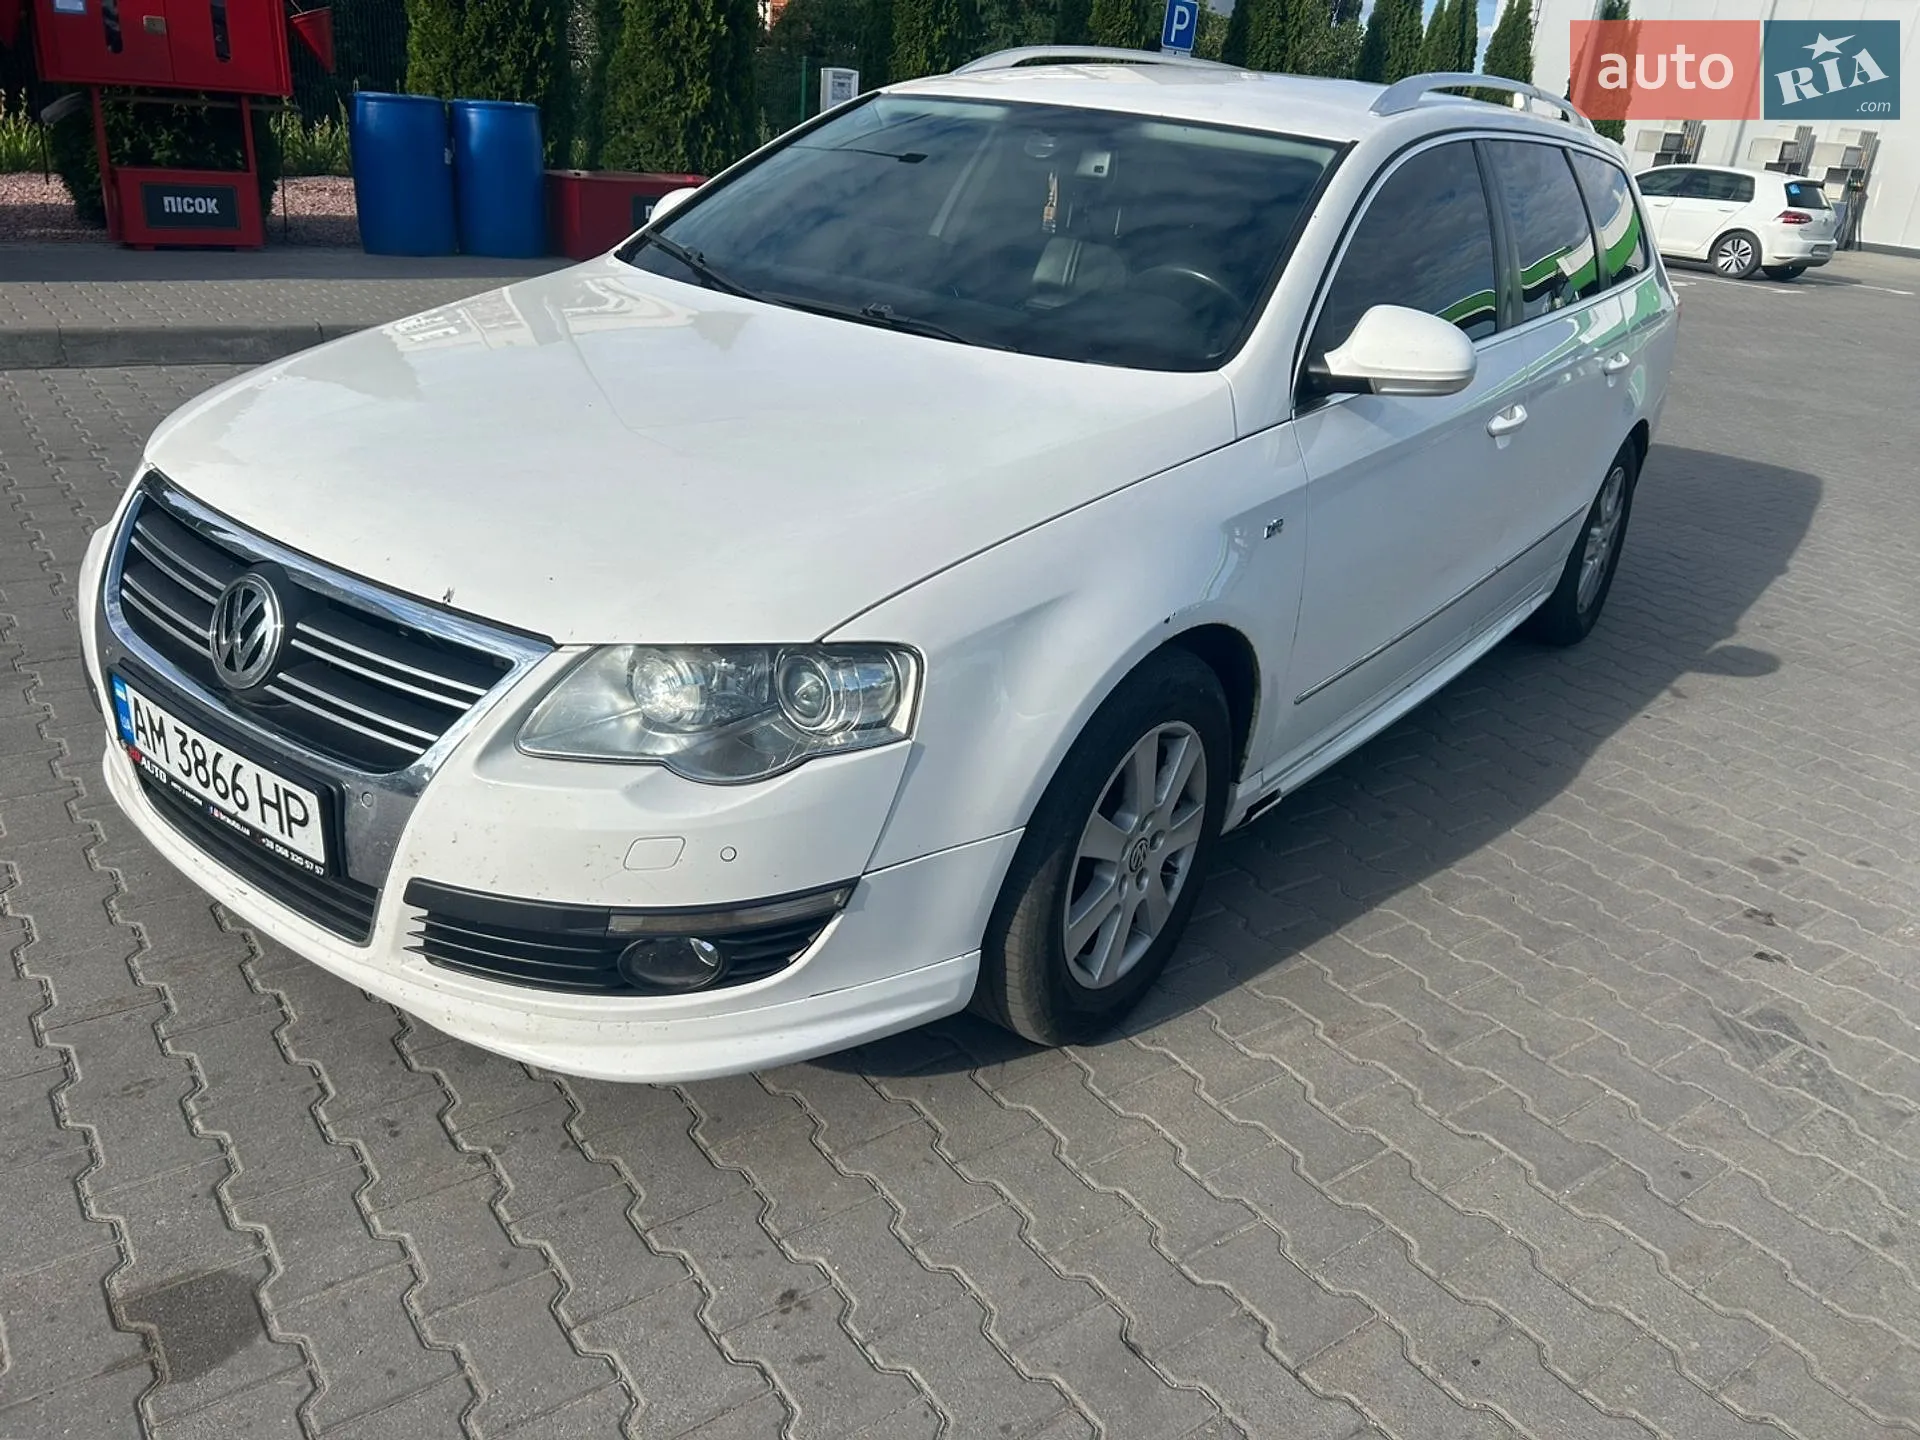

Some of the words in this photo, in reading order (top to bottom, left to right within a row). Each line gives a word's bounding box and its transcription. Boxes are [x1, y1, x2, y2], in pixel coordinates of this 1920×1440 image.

[1171, 5, 1190, 42] P
[163, 196, 219, 214] ПІСОК
[134, 696, 170, 764] AM
[174, 725, 249, 813] 3866
[255, 772, 310, 839] HP
